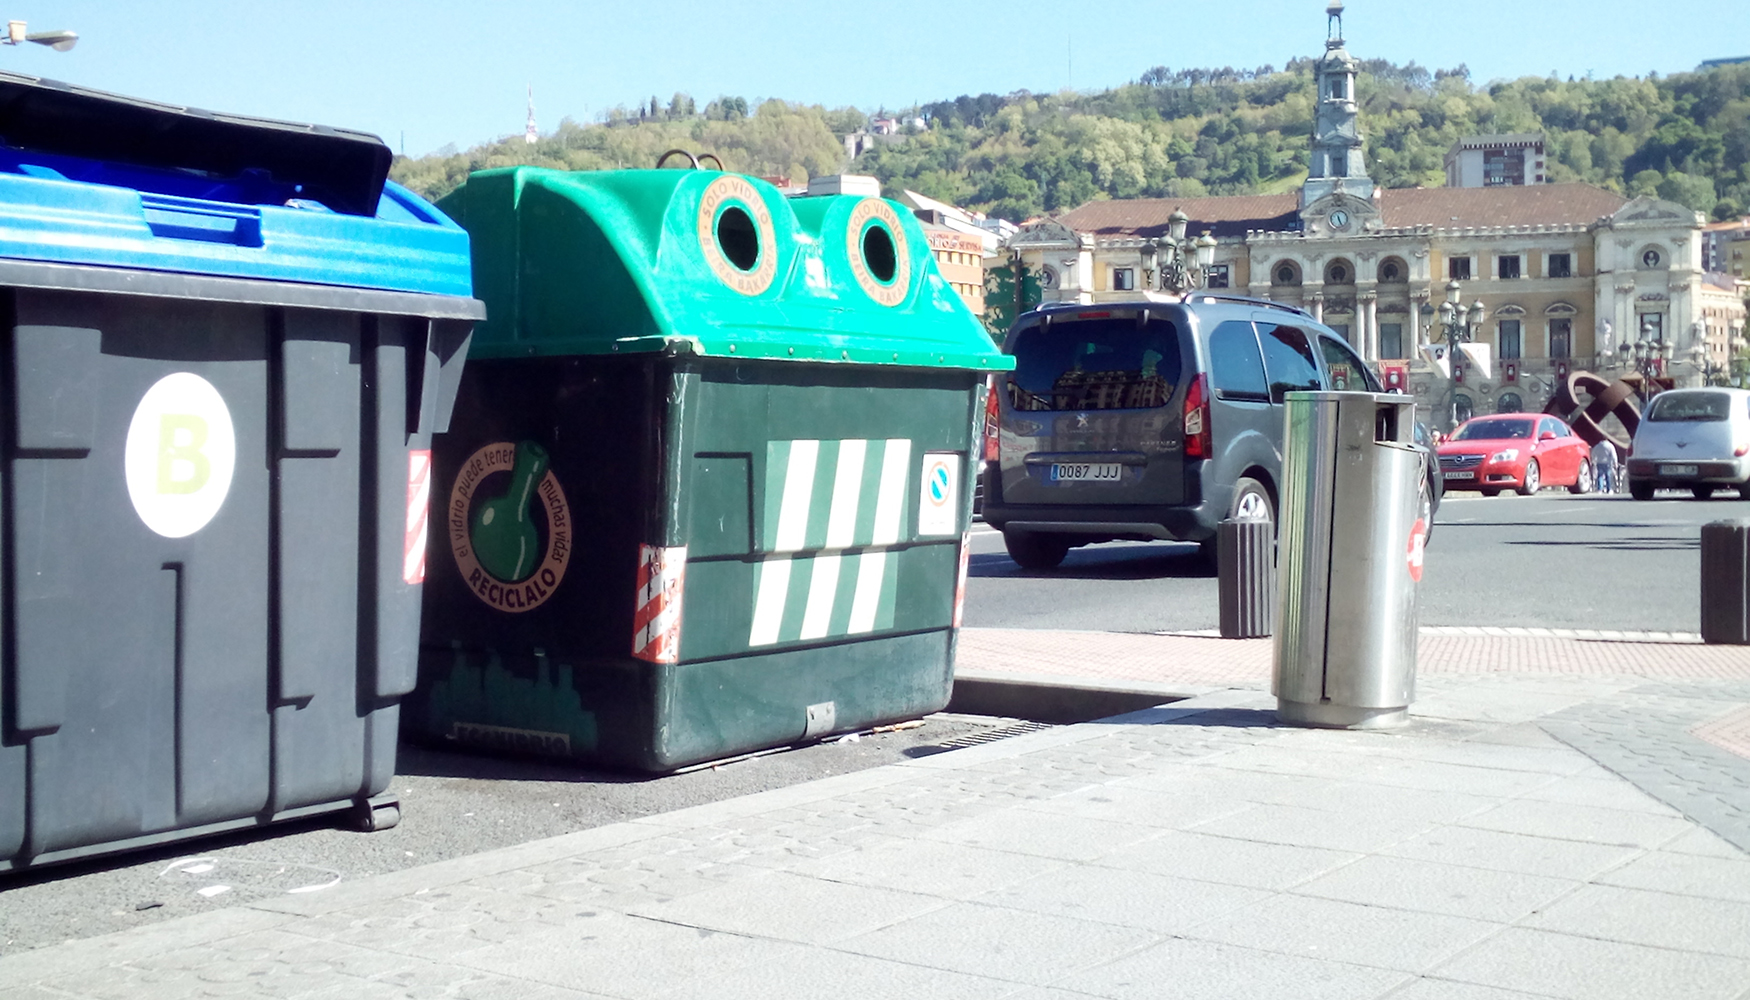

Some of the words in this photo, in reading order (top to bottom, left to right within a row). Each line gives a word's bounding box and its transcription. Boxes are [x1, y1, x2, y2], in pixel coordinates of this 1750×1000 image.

[702, 182, 728, 218] SOLO
[731, 180, 769, 225] VIDRIO
[850, 204, 871, 237] SOLO
[873, 202, 903, 242] VIDRIO
[702, 237, 733, 283] BEIRA
[737, 243, 774, 293] BAKARRIK
[850, 253, 875, 295] BEIRA
[879, 260, 909, 304] BAKARRIK
[156, 413, 211, 495] B
[485, 449, 514, 467] tener
[1059, 465, 1090, 478] 0087
[1094, 466, 1119, 478] JJJ
[458, 458, 484, 498] puede
[451, 499, 465, 541] vidrio
[541, 478, 566, 527] muchas
[454, 546, 469, 558] el
[551, 528, 569, 564] vidas
[469, 567, 556, 608] RECICLALO
